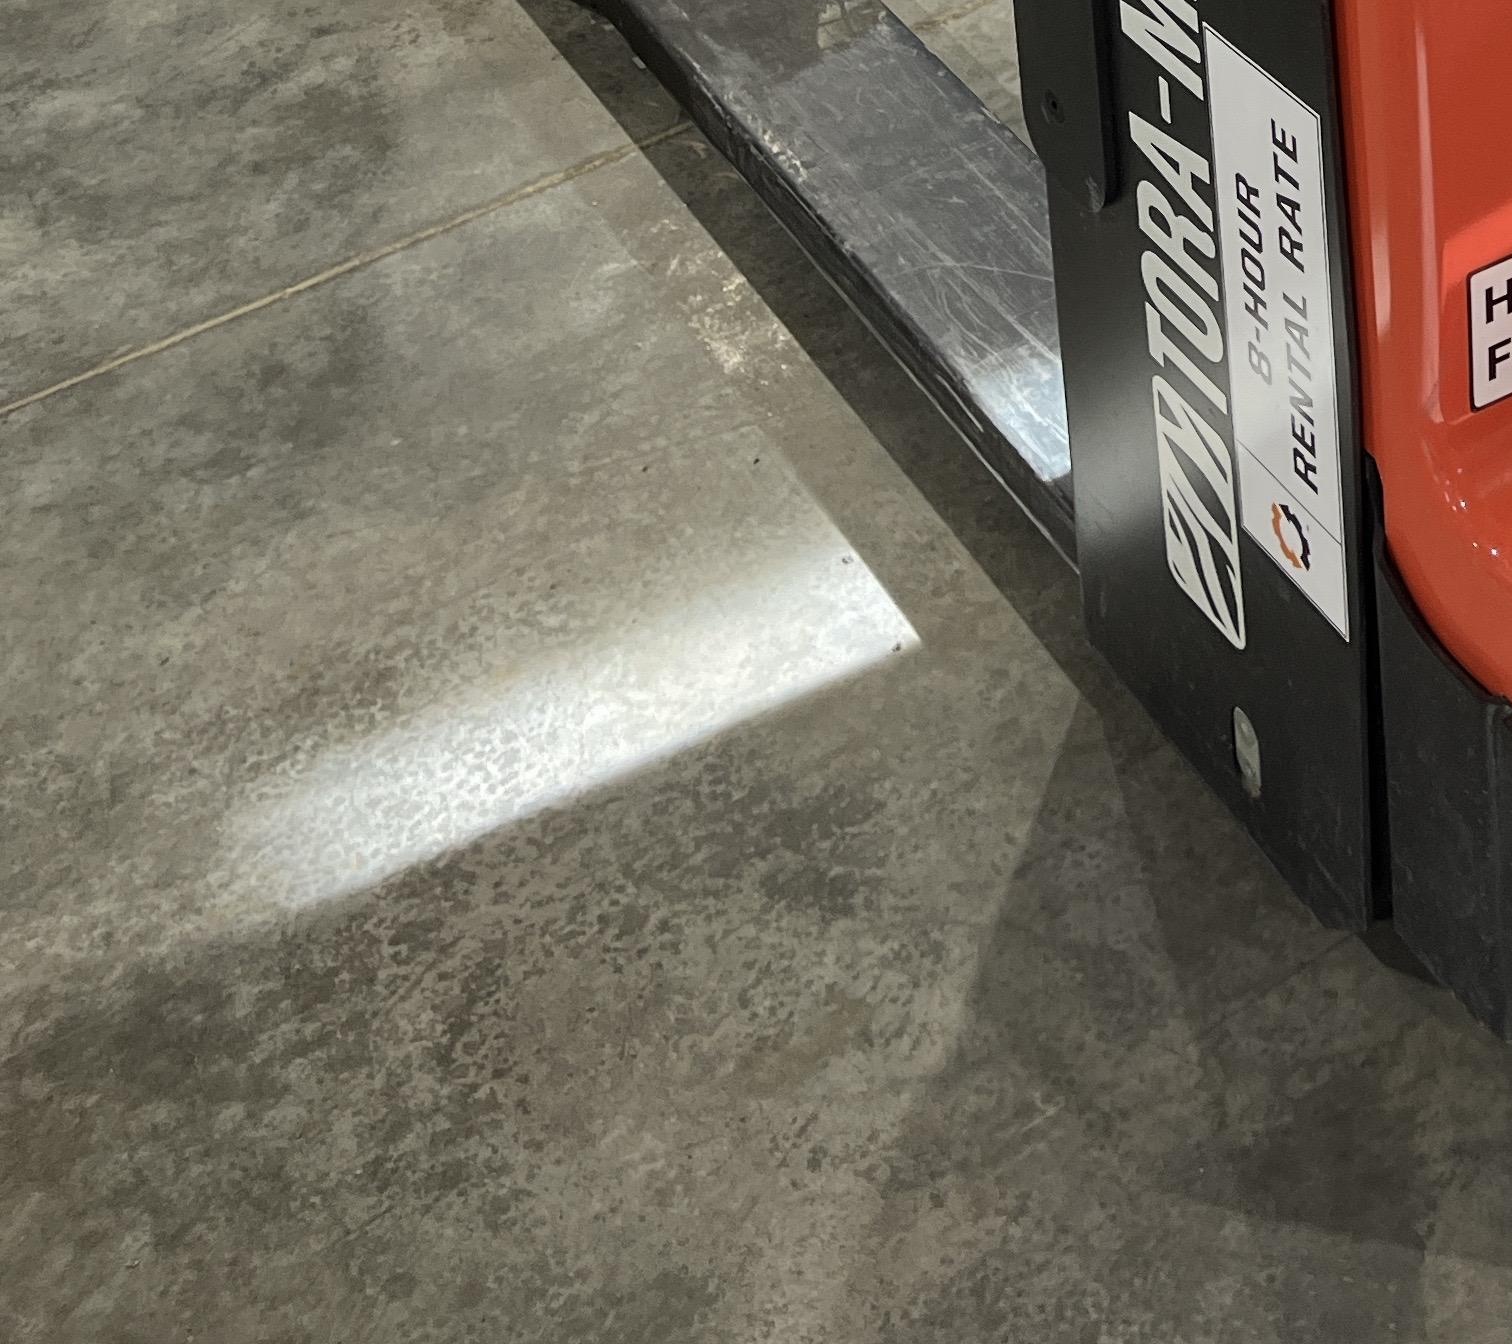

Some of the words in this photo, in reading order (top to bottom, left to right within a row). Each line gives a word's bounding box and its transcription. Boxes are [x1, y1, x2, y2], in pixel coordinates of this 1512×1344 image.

[1235, 171, 1275, 389] 8-HOUR
[1270, 116, 1311, 274] RATE
[1284, 292, 1321, 498] RENTAL
